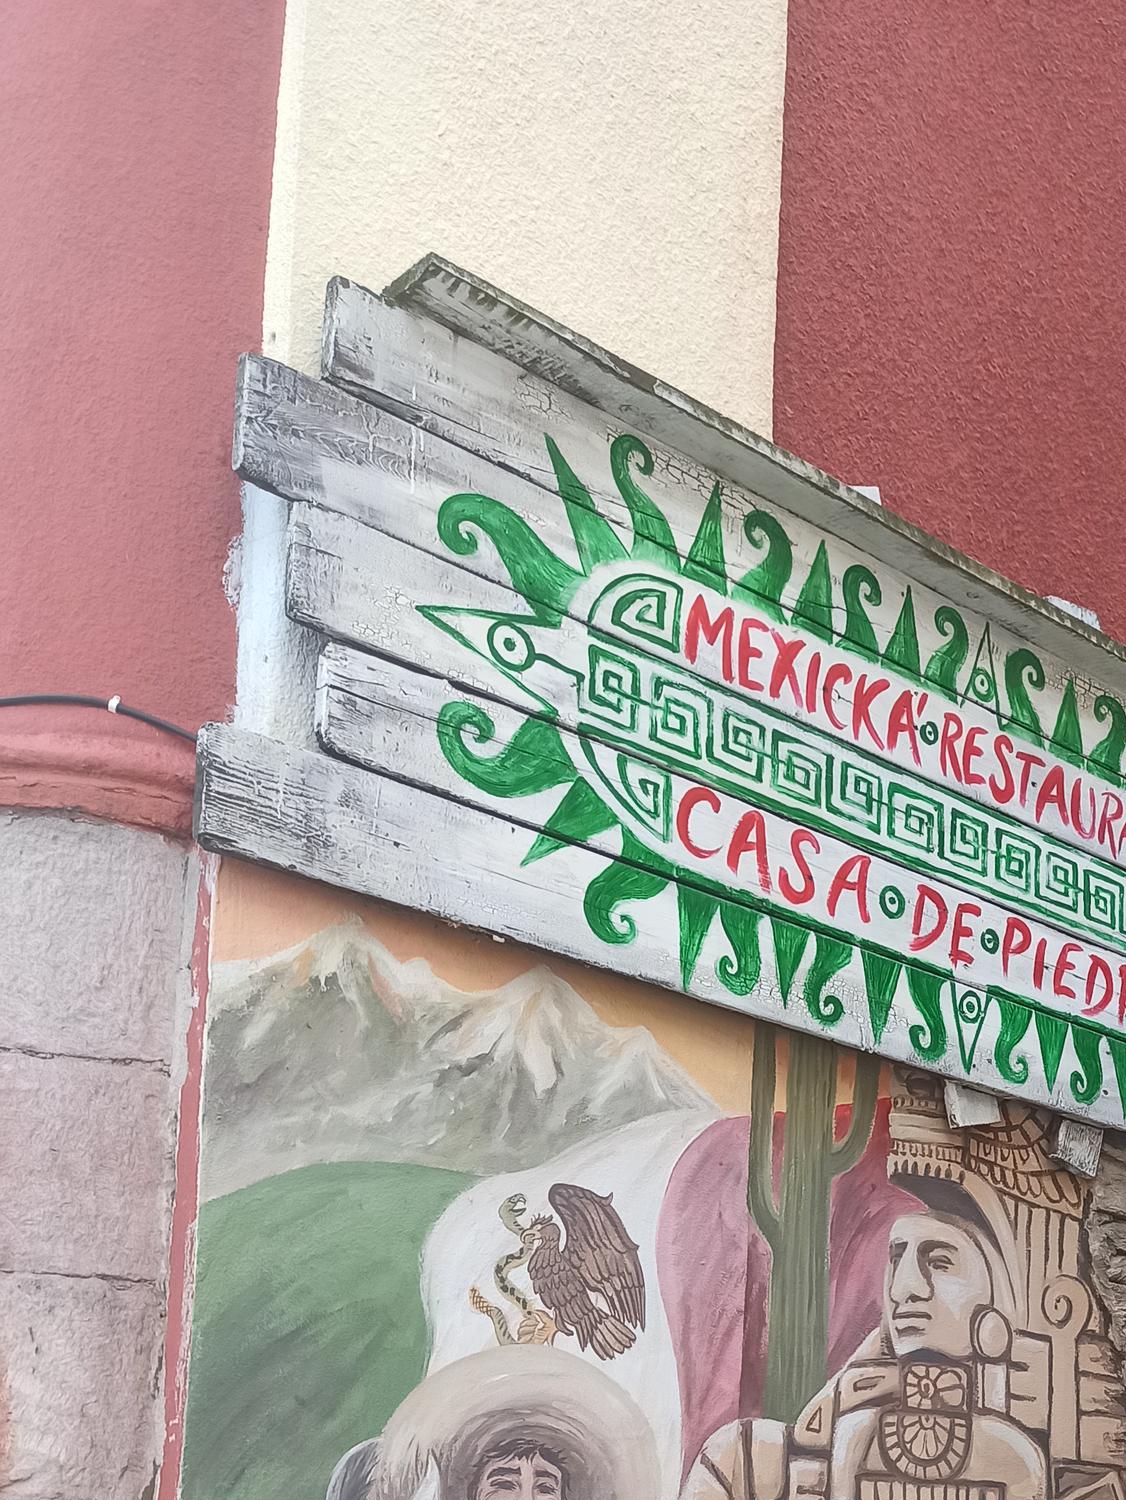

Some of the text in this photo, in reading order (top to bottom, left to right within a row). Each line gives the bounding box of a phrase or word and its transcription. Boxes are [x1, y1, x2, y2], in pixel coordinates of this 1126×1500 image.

[683, 593, 926, 767] MEXICKÁ
[675, 786, 872, 925] CASA
[910, 884, 982, 969] DE
